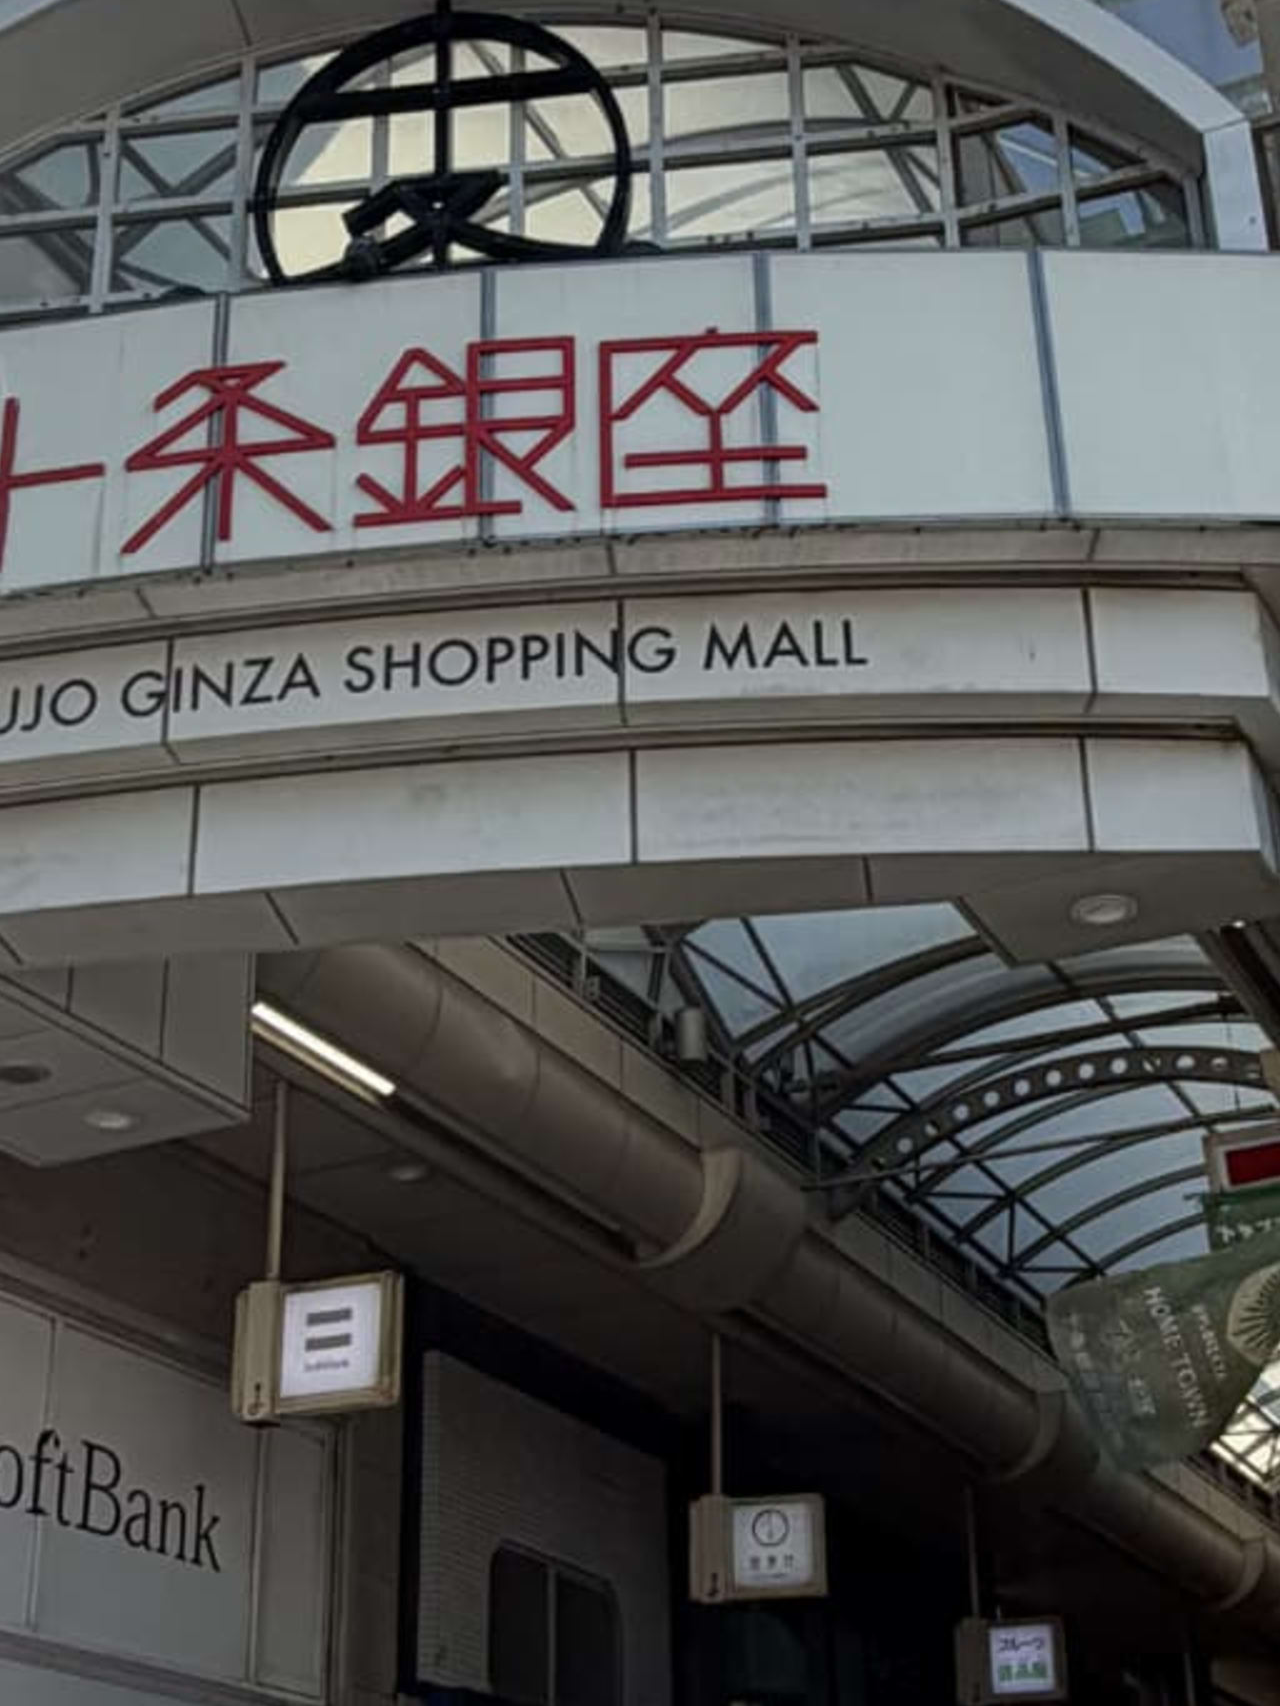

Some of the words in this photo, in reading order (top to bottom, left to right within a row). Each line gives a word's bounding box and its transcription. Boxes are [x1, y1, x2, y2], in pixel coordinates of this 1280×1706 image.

[119, 655, 320, 723] GINZA
[343, 623, 678, 698] SHOPPING
[702, 615, 869, 675] MALL
